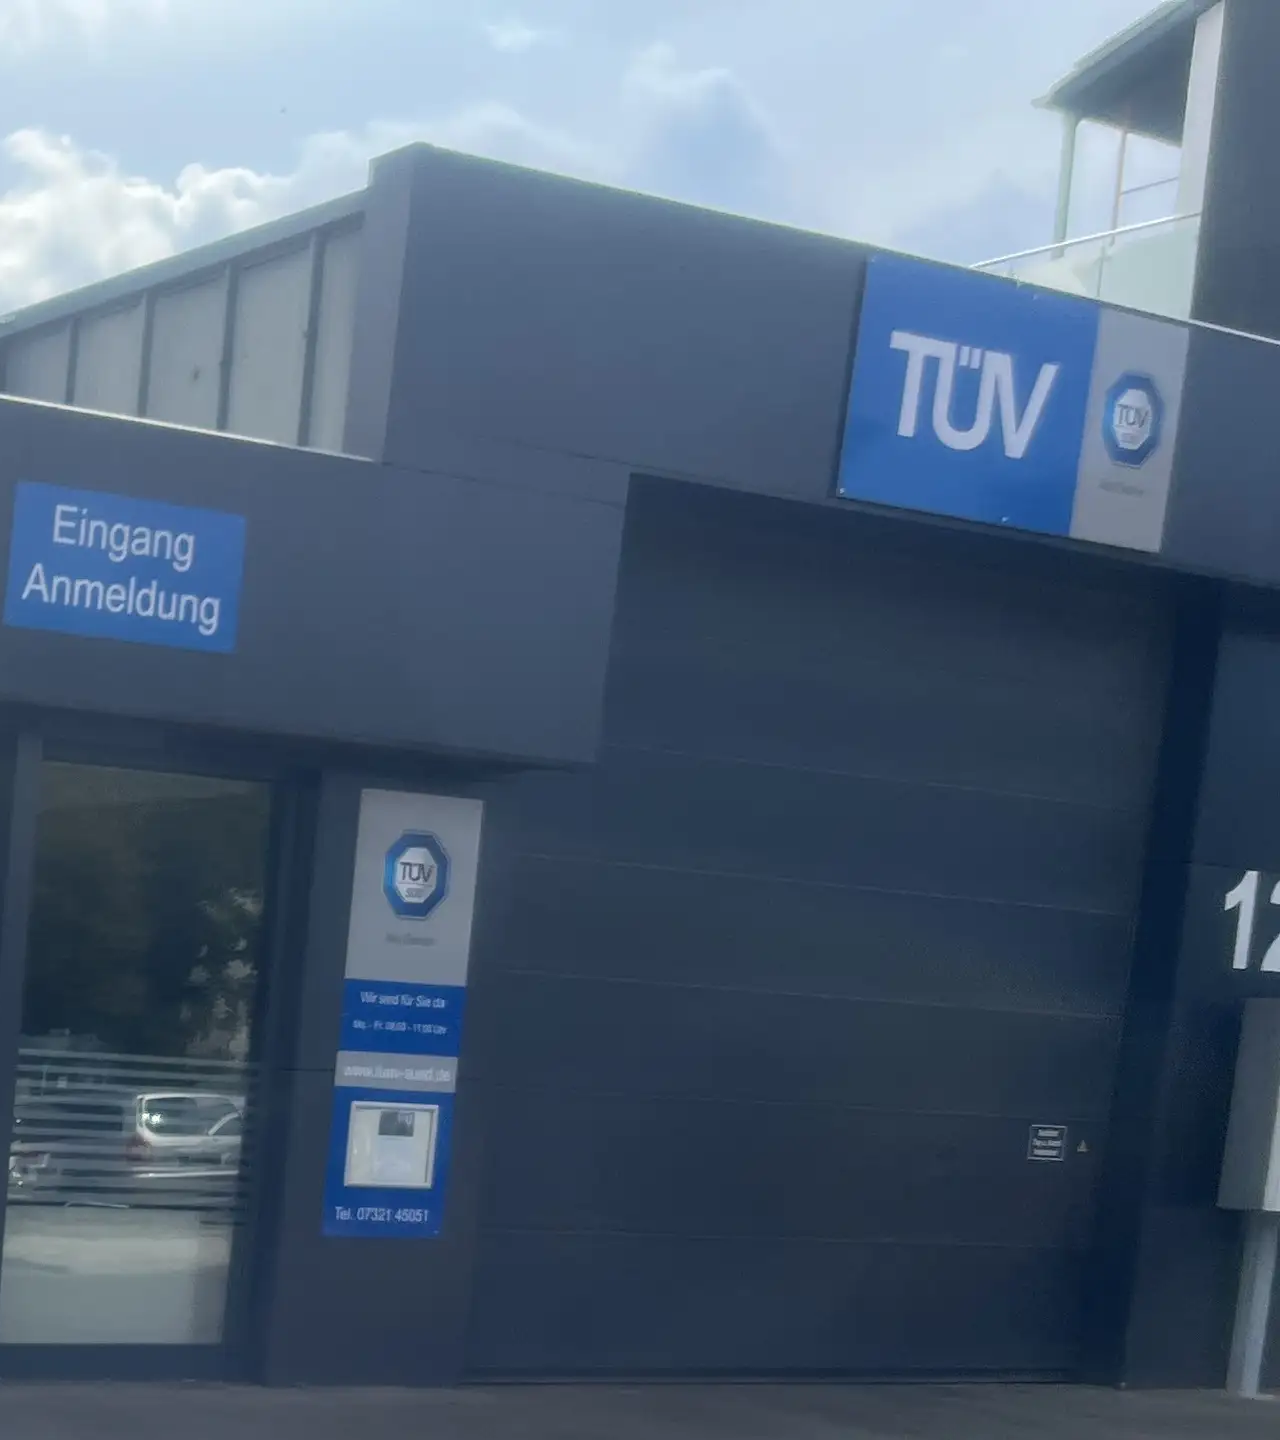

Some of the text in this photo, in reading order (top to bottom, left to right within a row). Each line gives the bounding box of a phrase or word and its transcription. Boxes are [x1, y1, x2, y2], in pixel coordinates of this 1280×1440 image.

[889, 330, 1060, 459] TÜV
[52, 503, 195, 572] Eingang
[21, 563, 221, 636] Anmeldung
[400, 861, 435, 882] TÜV
[335, 1206, 352, 1221] Tel.
[357, 1207, 390, 1222] 07321
